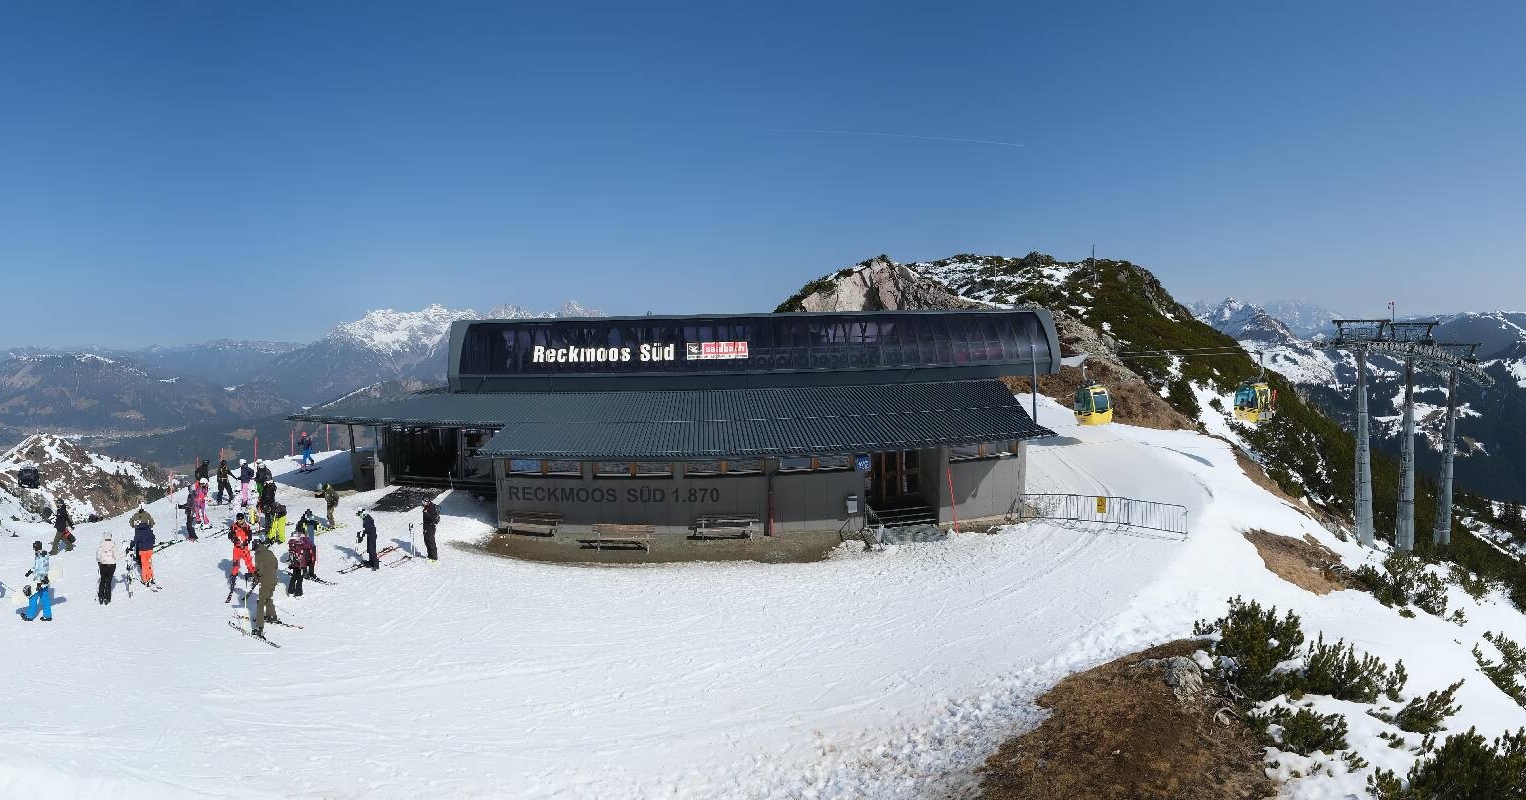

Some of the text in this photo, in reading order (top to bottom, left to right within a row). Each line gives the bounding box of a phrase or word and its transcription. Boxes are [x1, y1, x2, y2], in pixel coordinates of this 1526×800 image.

[532, 343, 675, 363] Reckmoos Süd
[508, 485, 720, 502] RECKMOOS SÜD 1.870
